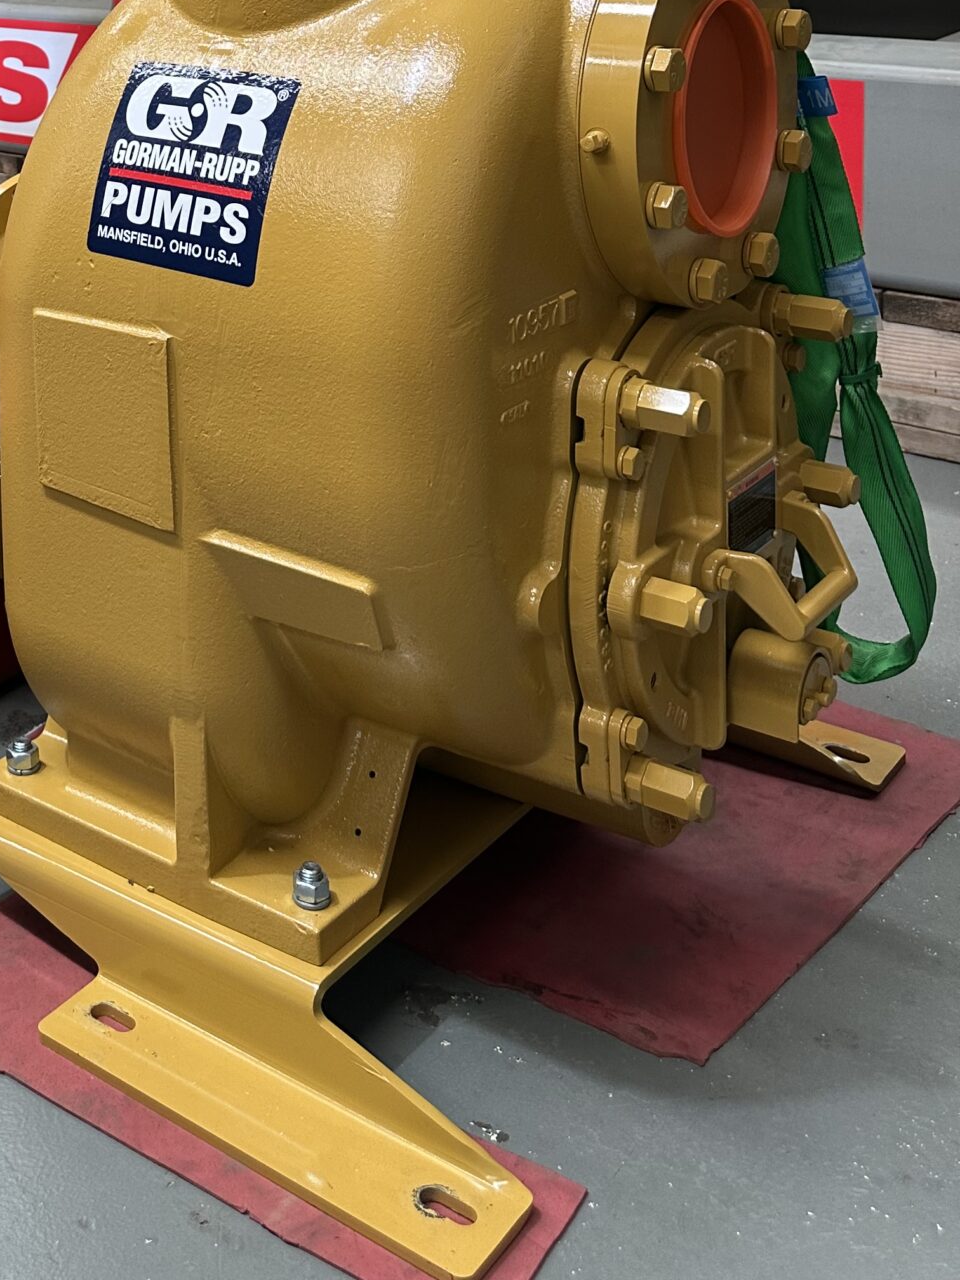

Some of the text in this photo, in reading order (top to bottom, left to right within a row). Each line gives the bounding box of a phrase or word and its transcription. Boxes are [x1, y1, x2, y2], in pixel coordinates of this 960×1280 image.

[112, 138, 261, 186] GORMAN-RUPP
[100, 180, 250, 245] PUMPS
[97, 224, 242, 268] MANSFIELD, OHIO U.S.A.
